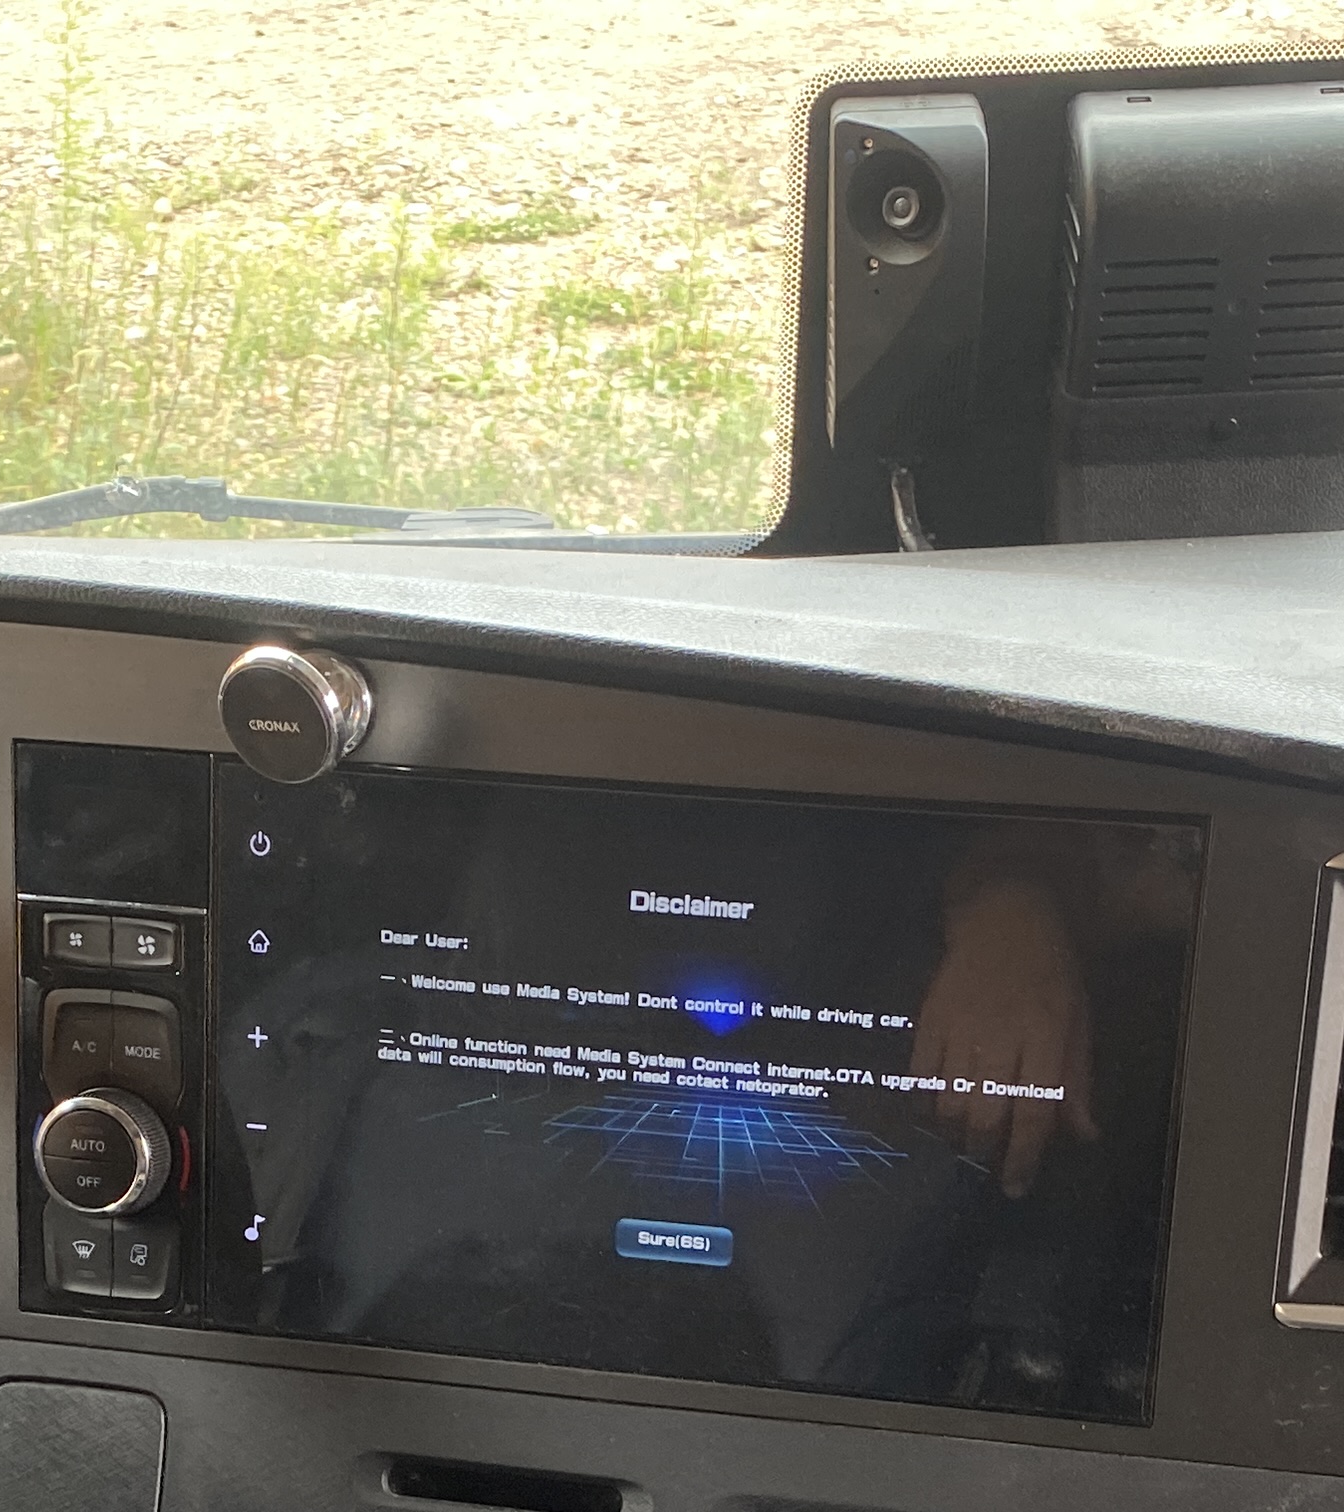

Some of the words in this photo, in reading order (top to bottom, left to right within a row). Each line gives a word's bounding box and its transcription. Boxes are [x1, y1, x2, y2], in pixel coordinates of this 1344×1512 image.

[248, 719, 301, 734] CRONAX
[629, 889, 755, 920] Disclaimer
[380, 929, 419, 946] Dear
[425, 933, 469, 951] User:
[411, 974, 477, 994] Welcome
[482, 982, 511, 996] use
[516, 982, 561, 1001] Media
[567, 986, 631, 1007] System!
[637, 993, 679, 1011] Dont
[684, 1000, 745, 1016] control
[751, 1002, 764, 1018] it
[770, 1004, 812, 1022] while
[817, 1007, 875, 1030] driving
[879, 1013, 914, 1030] car.
[124, 1045, 162, 1060] MODE
[377, 1046, 413, 1063] data
[418, 1050, 443, 1066] will
[448, 1053, 546, 1075] consumption
[553, 1061, 590, 1081] flow,
[597, 1066, 627, 1084] you
[632, 1070, 671, 1086] need
[675, 1074, 731, 1092] cotact
[736, 1080, 830, 1100] netoprator.
[409, 1031, 459, 1051] Online
[464, 1036, 529, 1057] function
[534, 1044, 572, 1061] need
[577, 1045, 622, 1066] Media
[627, 1050, 687, 1071] System
[692, 1055, 762, 1077] Connect
[881, 1073, 947, 1094] upgrade
[952, 1078, 976, 1094] Or
[982, 1080, 1066, 1102] Download
[70, 1138, 105, 1153] AUTO
[76, 1174, 101, 1188] OFF
